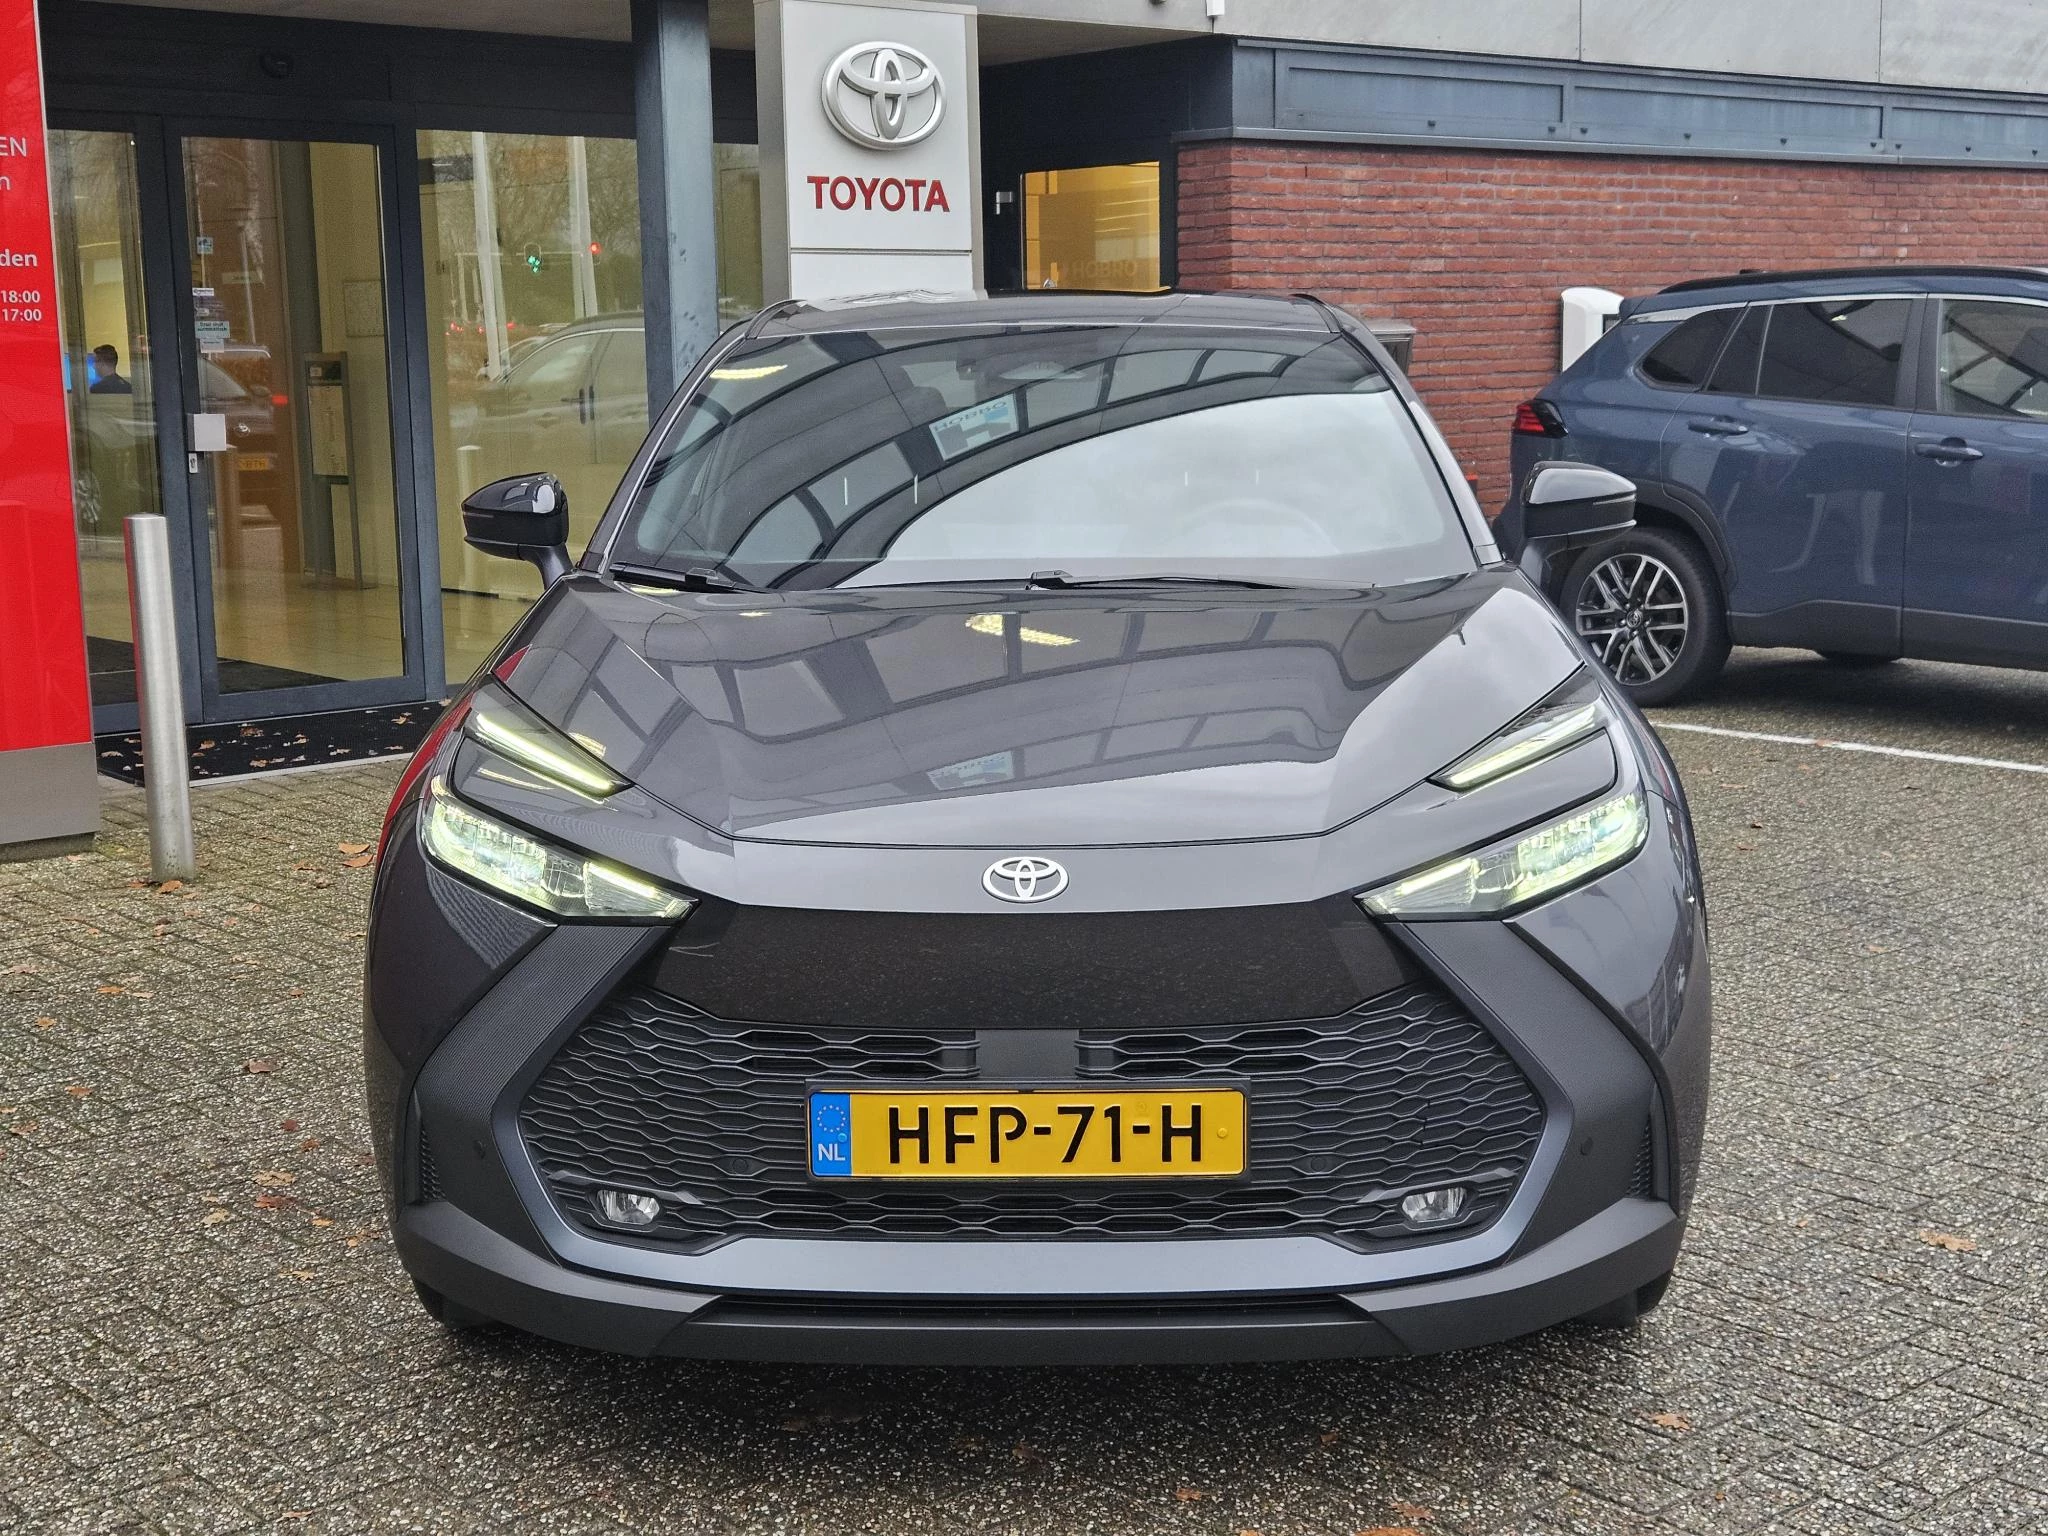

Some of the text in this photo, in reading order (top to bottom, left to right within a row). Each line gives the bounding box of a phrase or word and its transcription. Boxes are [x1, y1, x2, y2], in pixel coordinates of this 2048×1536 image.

[806, 175, 950, 212] TOYOTA
[0, 248, 38, 266] den
[0, 290, 40, 303] 18:00
[2, 308, 42, 321] 17:00
[817, 1104, 1202, 1164] NL HFP-71-H
